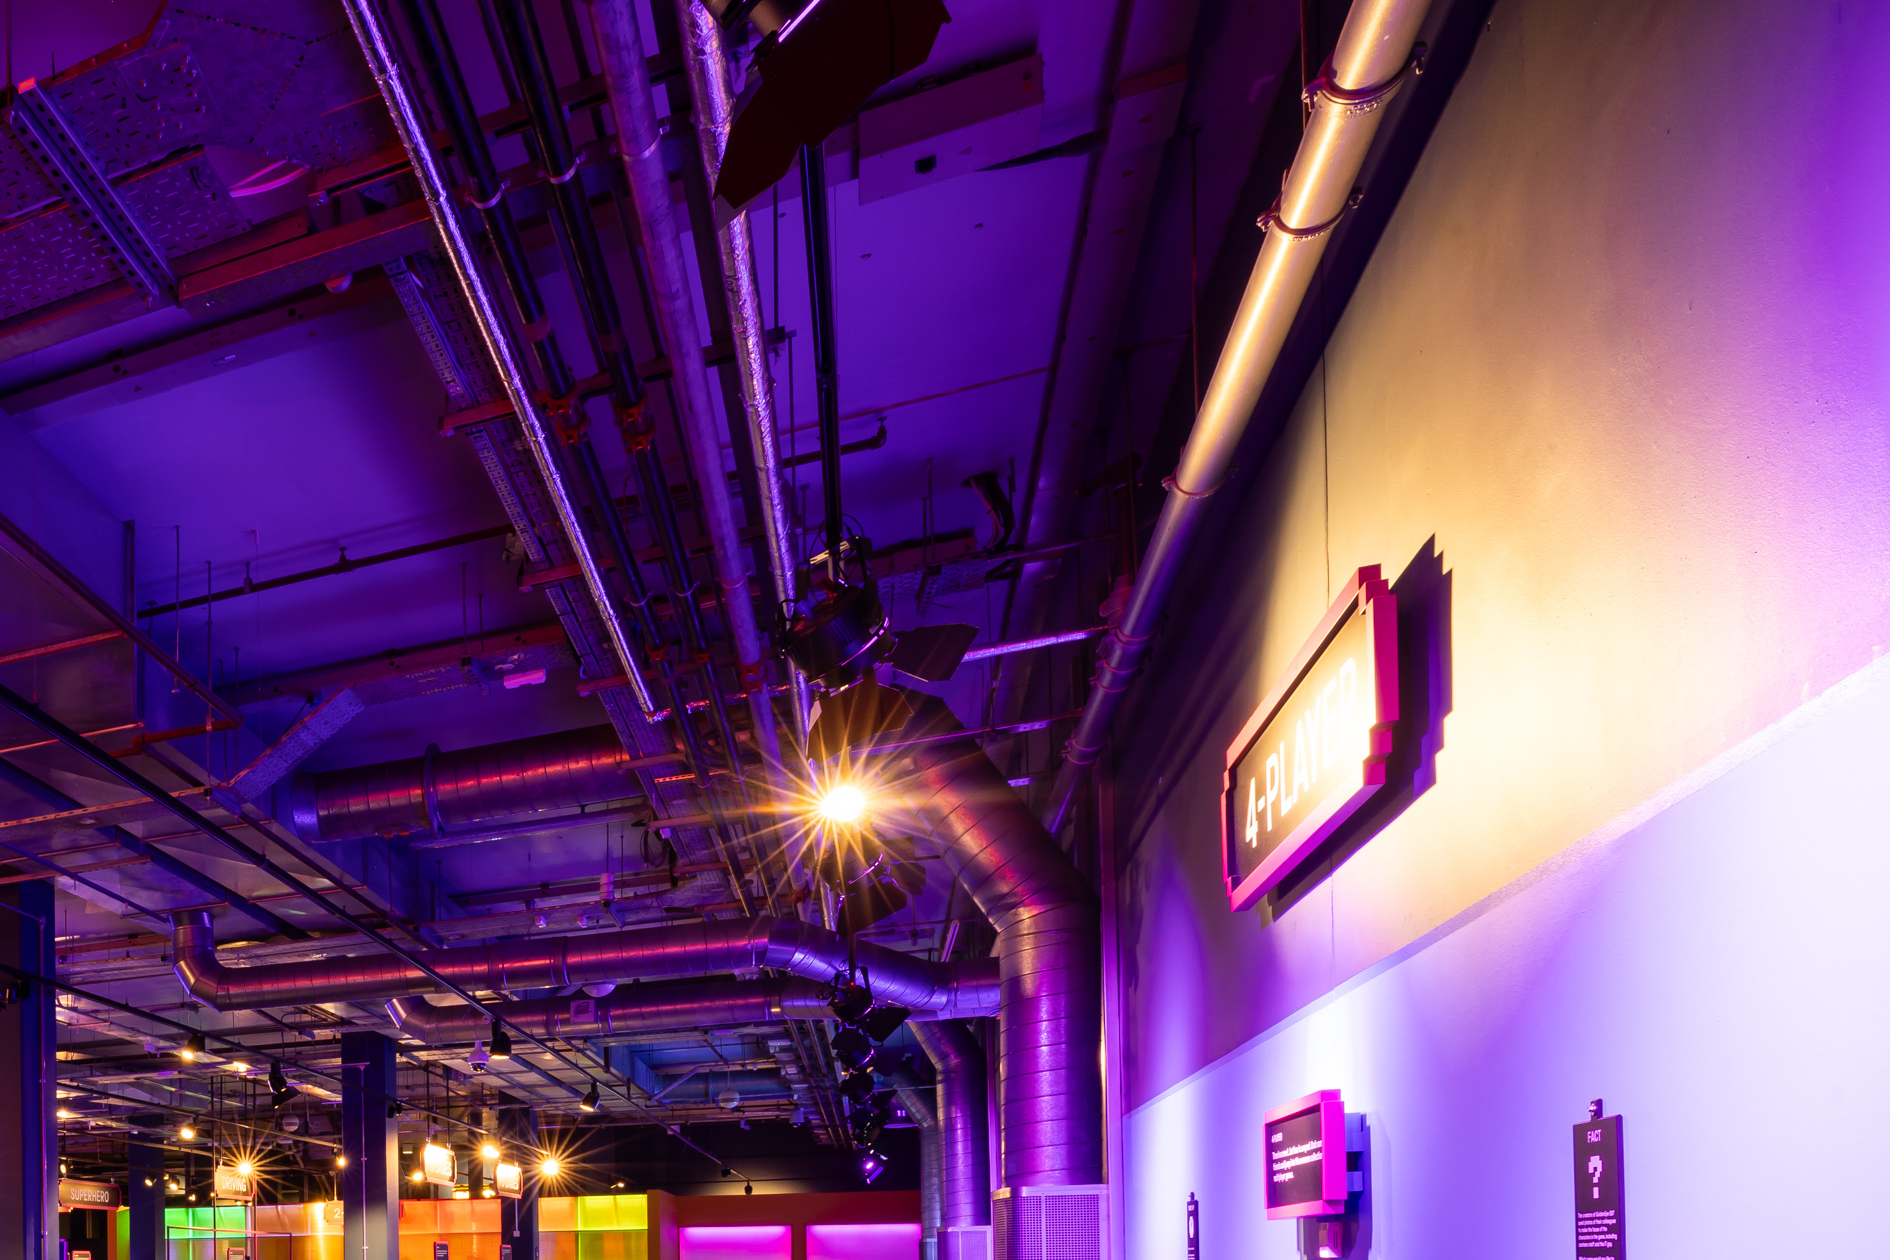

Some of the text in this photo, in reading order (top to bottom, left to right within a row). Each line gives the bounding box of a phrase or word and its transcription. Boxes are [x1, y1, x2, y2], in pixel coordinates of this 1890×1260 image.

[1246, 657, 1357, 848] 4-PLAYER
[1587, 1129, 1602, 1143] FACT
[222, 1176, 246, 1192] DRIVING
[70, 1188, 109, 1203] SUPERHERO
